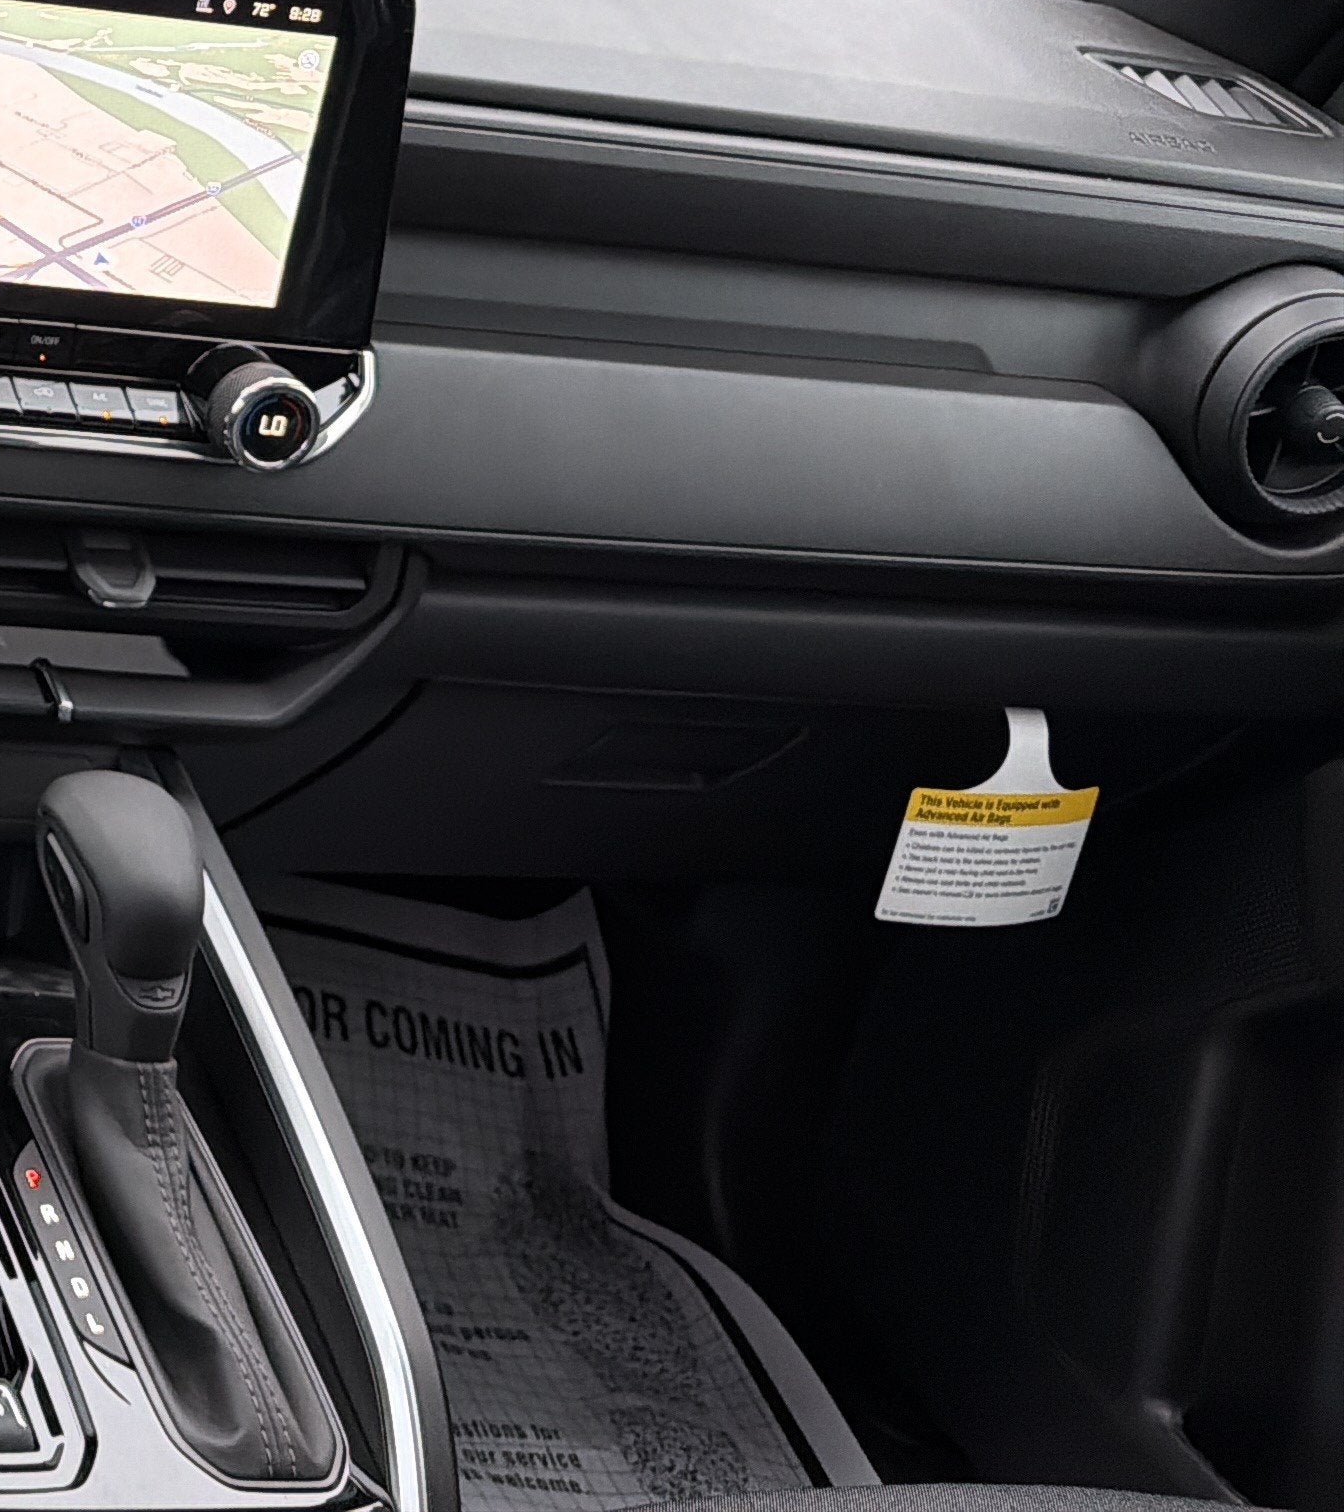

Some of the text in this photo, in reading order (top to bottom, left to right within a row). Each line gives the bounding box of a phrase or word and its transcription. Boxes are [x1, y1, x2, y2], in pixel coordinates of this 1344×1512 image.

[258, 414, 288, 438] LO
[921, 793, 942, 807] This
[945, 796, 983, 810] Vehicle
[995, 799, 1040, 812] Equipped
[916, 808, 969, 823] Advanced
[970, 811, 987, 823] Air
[291, 984, 584, 1080] OR COMING IN
[24, 1168, 42, 1189] P
[40, 1203, 60, 1224] R
[55, 1241, 76, 1262] N
[70, 1277, 90, 1299] D
[86, 1313, 105, 1336] L
[502, 1445, 582, 1469] service
